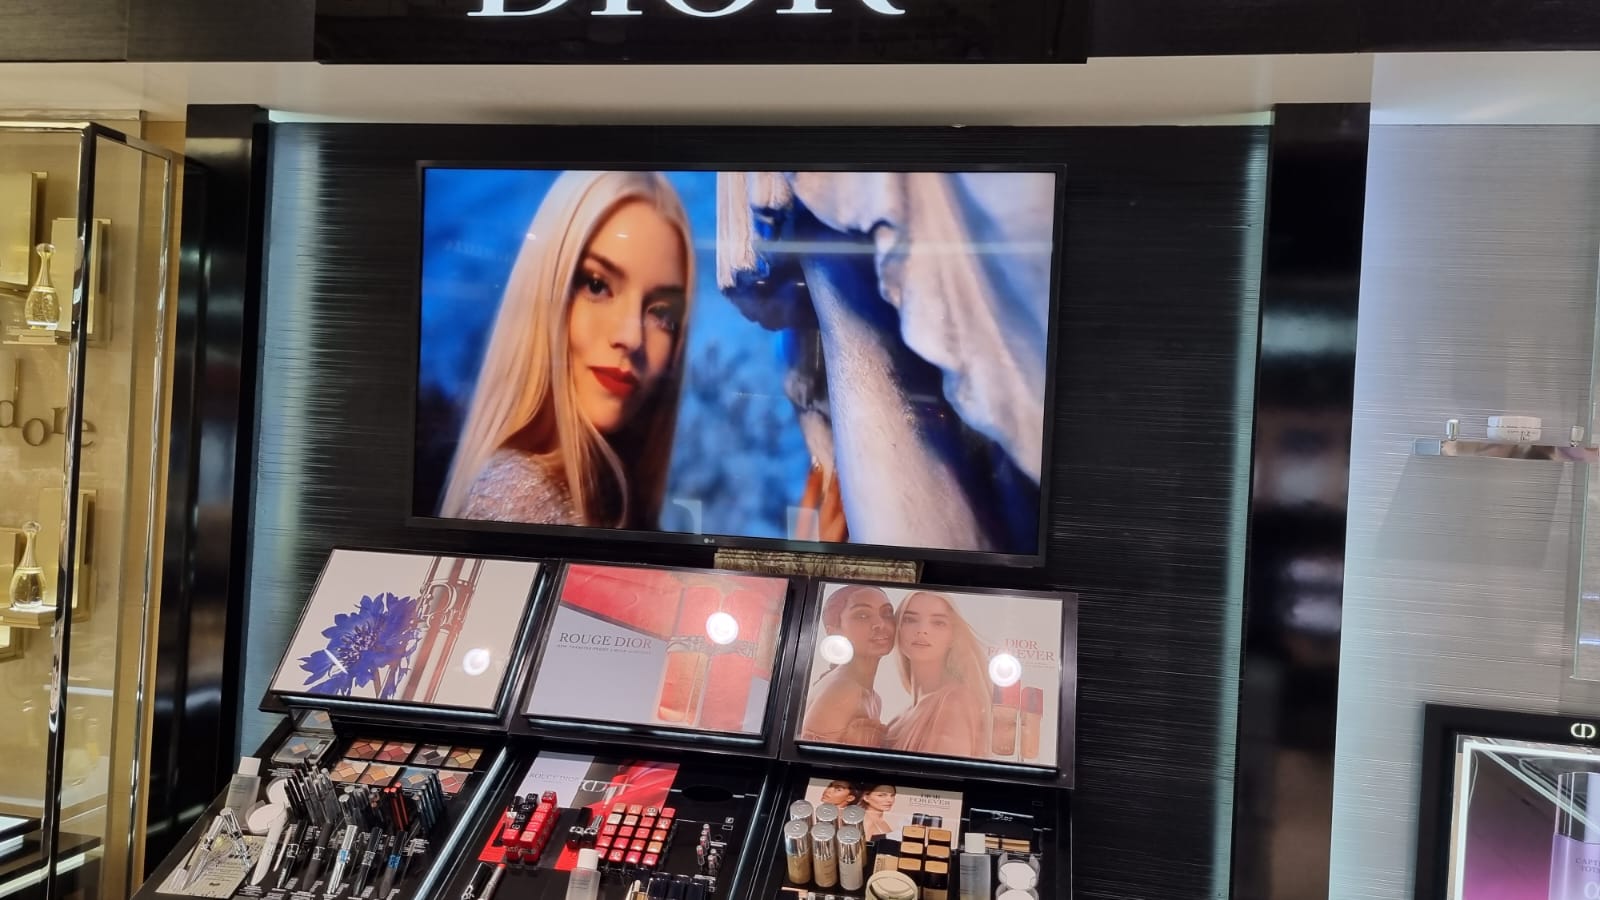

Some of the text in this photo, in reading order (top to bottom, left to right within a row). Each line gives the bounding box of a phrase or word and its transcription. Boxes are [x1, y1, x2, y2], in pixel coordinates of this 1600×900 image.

[559, 632, 612, 646] ROUGE
[614, 636, 652, 649] DIOR
[1005, 639, 1038, 650] DIOR
[1575, 857, 1600, 868] CAPT
